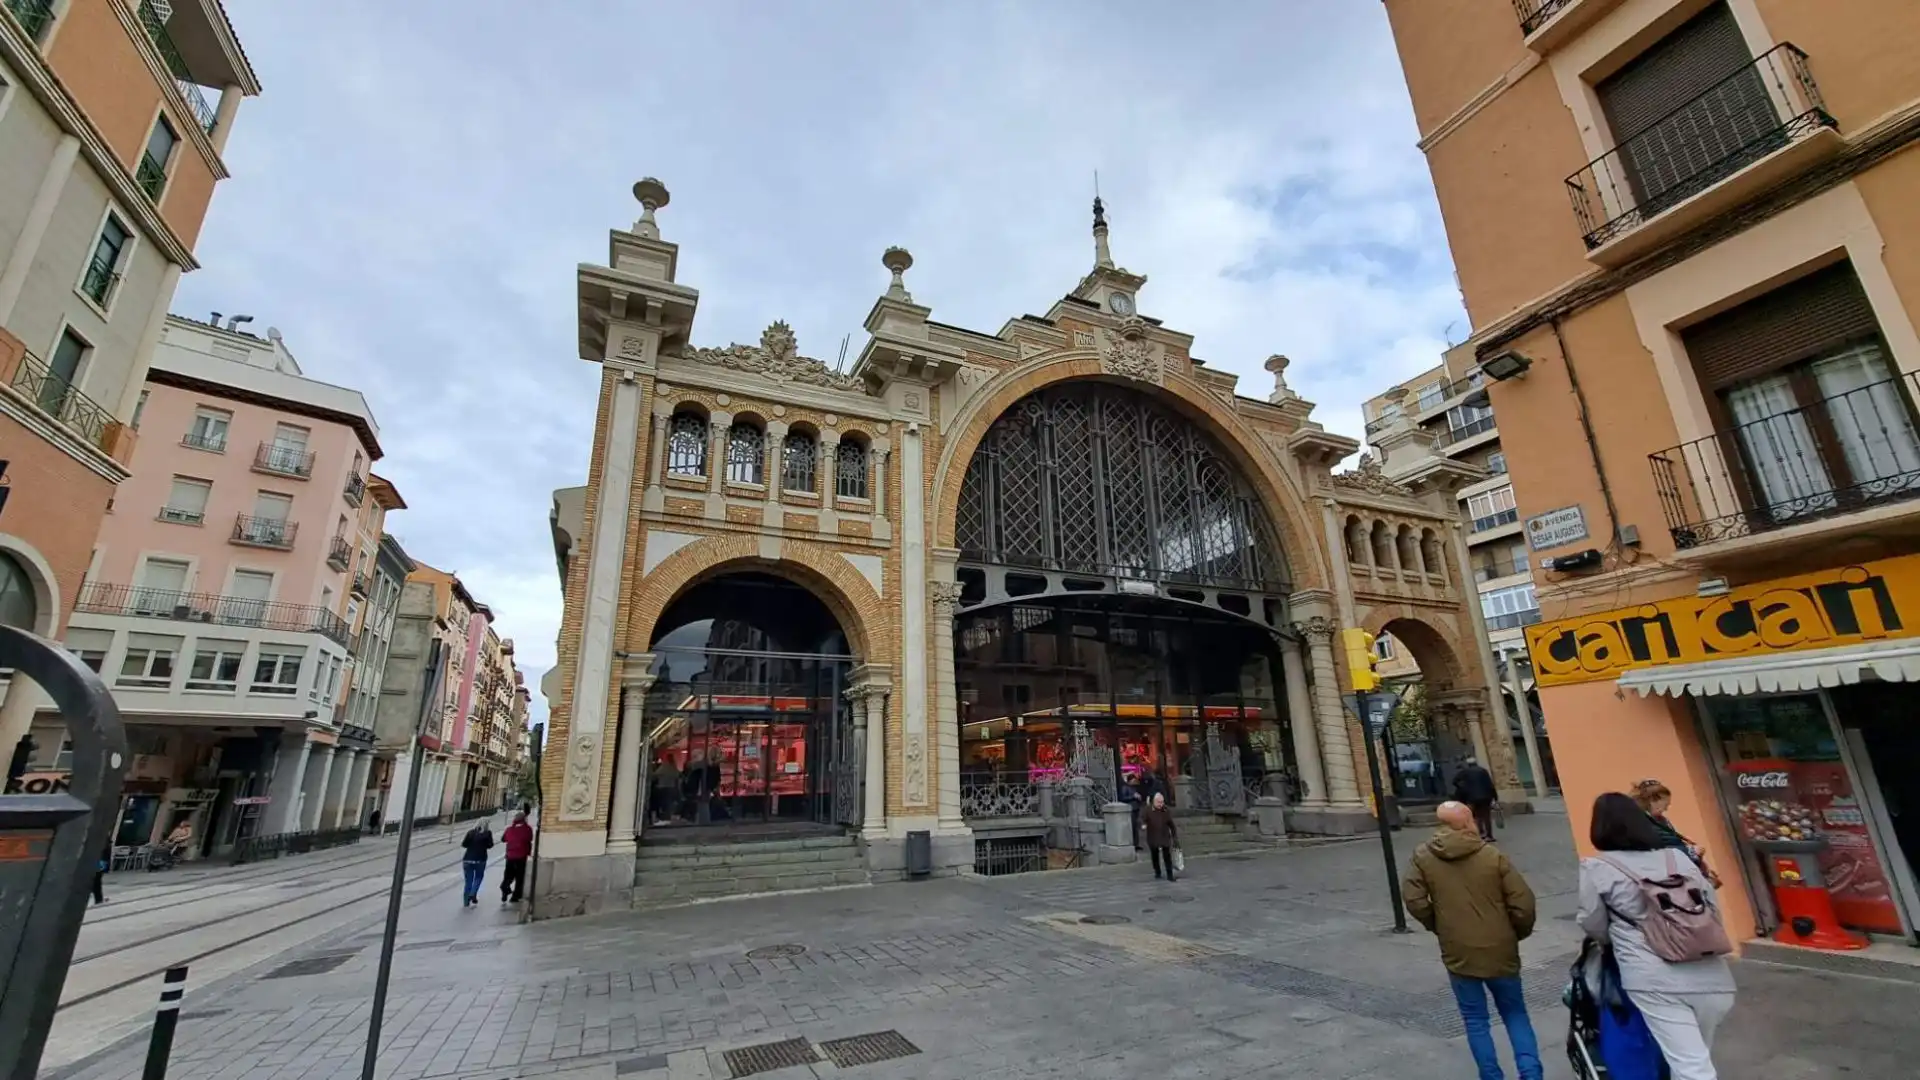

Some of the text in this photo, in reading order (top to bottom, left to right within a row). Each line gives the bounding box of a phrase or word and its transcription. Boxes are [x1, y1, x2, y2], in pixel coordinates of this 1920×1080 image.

[1544, 511, 1579, 527] AVENIDA
[1554, 523, 1585, 540] AUGUSTO
[1737, 772, 1789, 788] Coca-Cola
